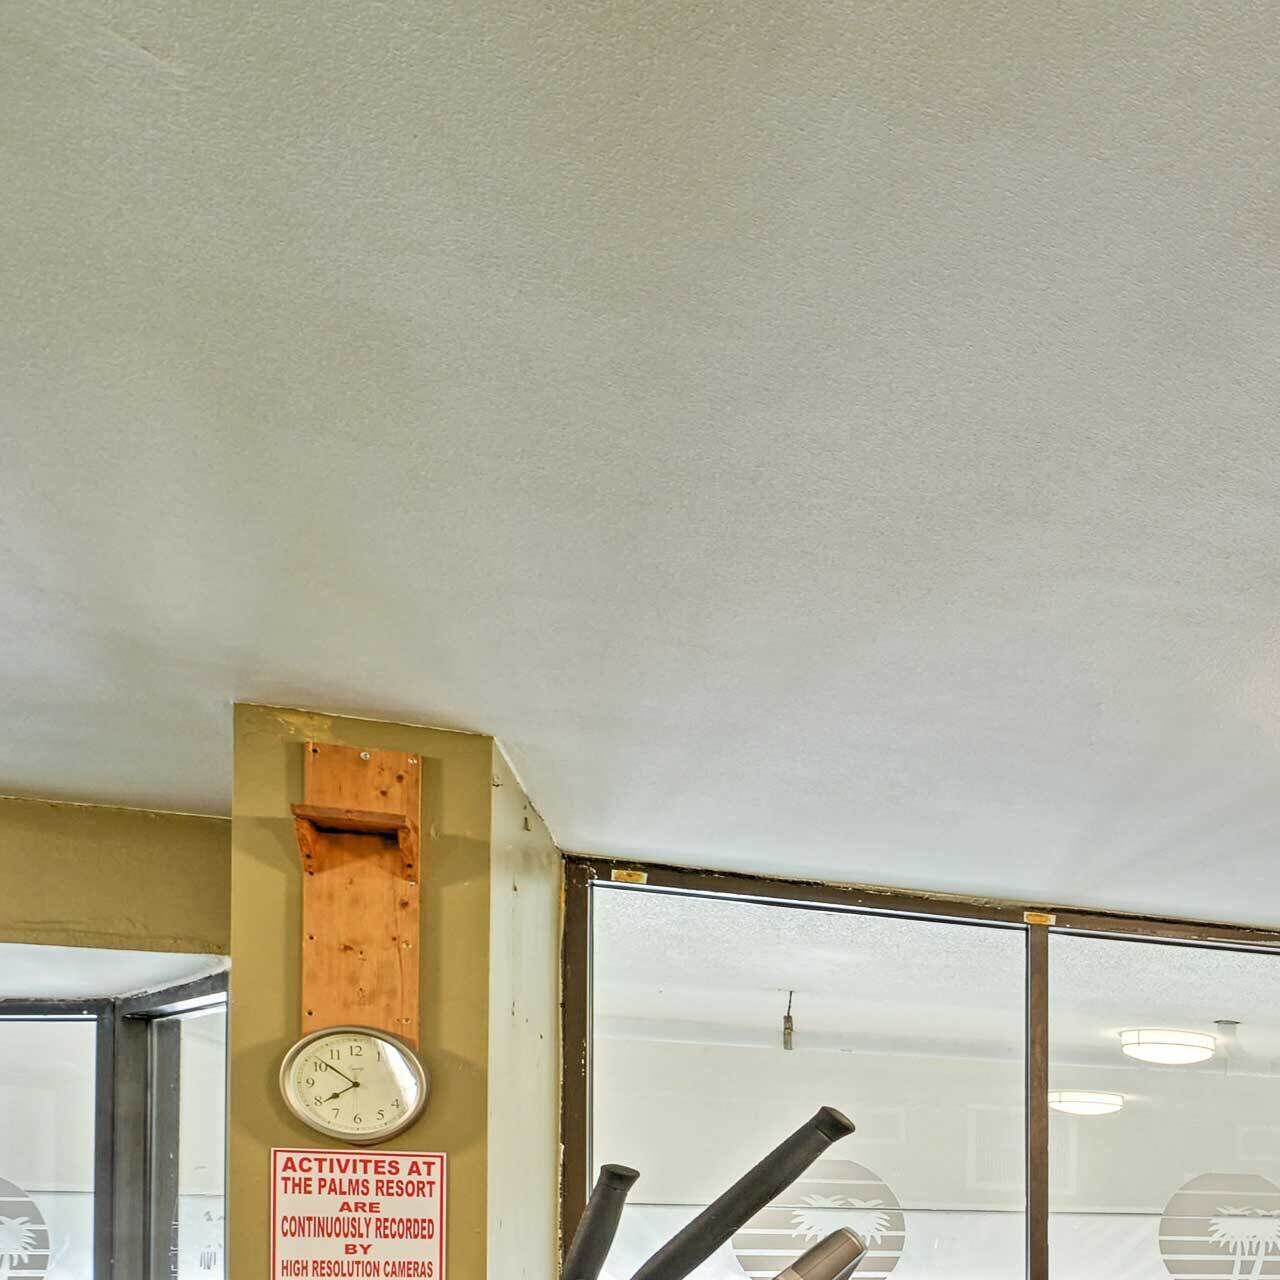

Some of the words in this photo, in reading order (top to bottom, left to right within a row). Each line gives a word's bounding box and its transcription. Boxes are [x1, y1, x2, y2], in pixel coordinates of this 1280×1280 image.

[330, 1049, 341, 1061] 11
[349, 1045, 363, 1057] 12
[313, 1061, 328, 1073] 10
[306, 1077, 315, 1089] 9
[314, 1095, 324, 1107] 8
[332, 1108, 341, 1119] 7
[353, 1113, 363, 1125] 6
[376, 1110, 386, 1121] 5
[281, 1157, 401, 1177] ACTIVITES
[407, 1161, 436, 1177] AT
[281, 1177, 313, 1195] THE
[318, 1178, 370, 1197] PALMS
[375, 1179, 436, 1198] RESORT
[338, 1201, 381, 1214] ARE
[281, 1215, 372, 1239] CONTINUOUSLY
[375, 1217, 435, 1240] RECORDED
[344, 1243, 373, 1256] BY
[281, 1259, 309, 1278] HIGH
[311, 1259, 380, 1279] RESOLUTION
[383, 1260, 434, 1279] CAMERAS
